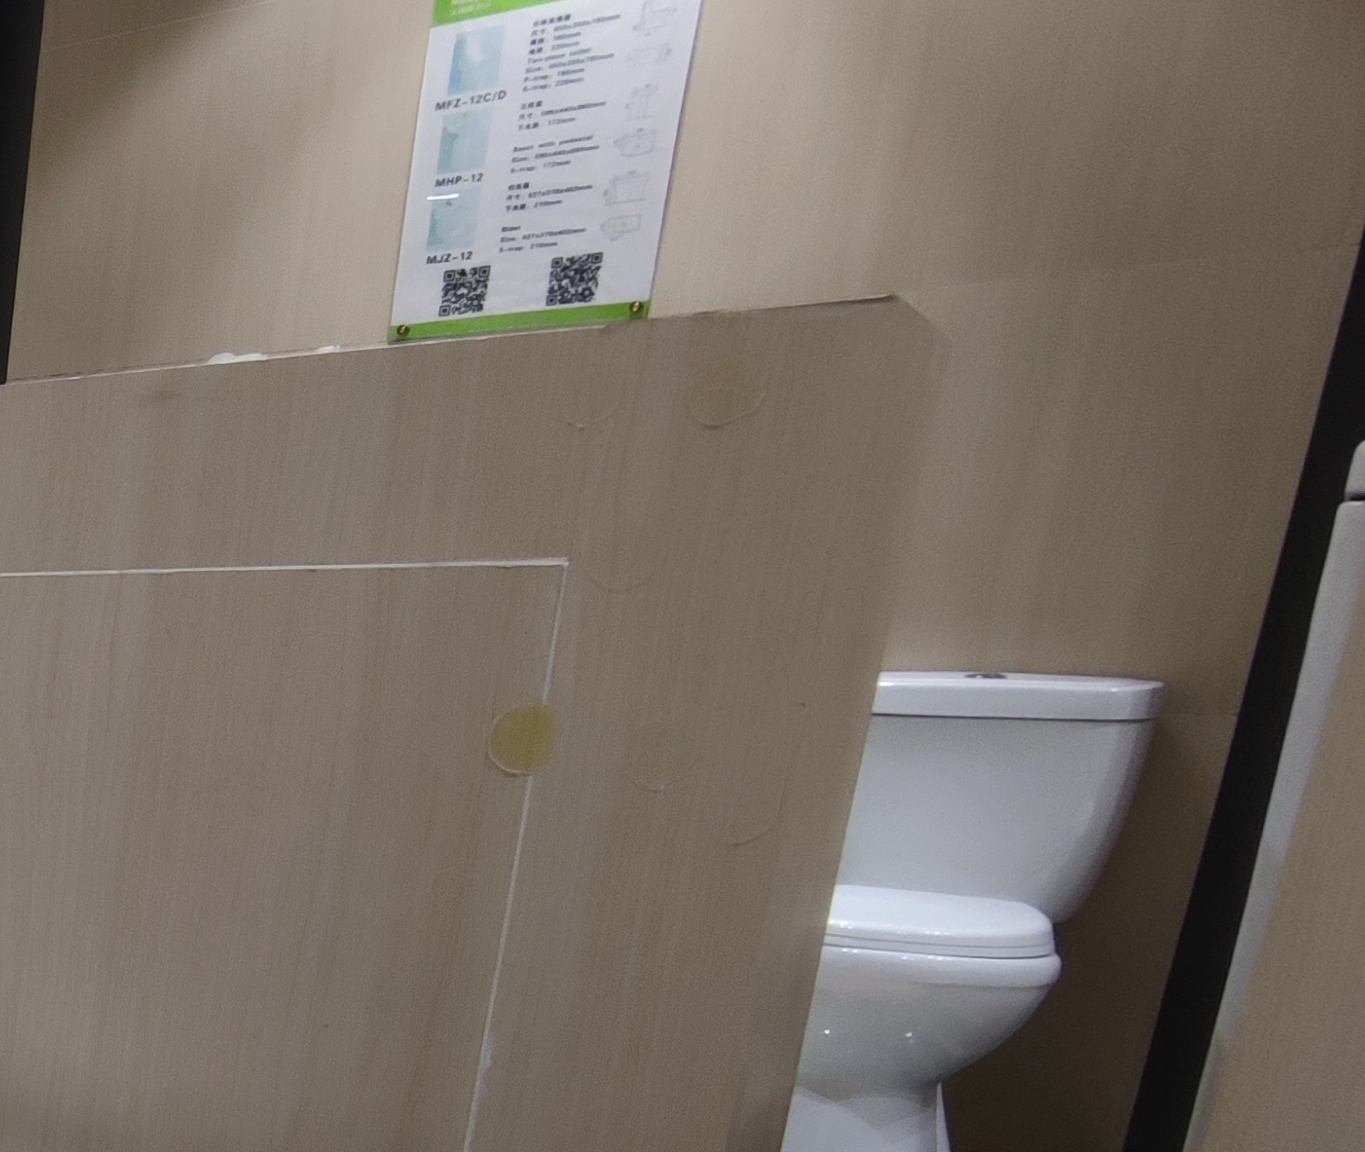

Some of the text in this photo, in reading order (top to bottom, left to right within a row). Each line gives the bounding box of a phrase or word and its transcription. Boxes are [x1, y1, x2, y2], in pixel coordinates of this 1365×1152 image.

[435, 90, 507, 111] MFZ-12C/D
[435, 172, 484, 188] MHP-12
[426, 250, 474, 265] MJZ-12
